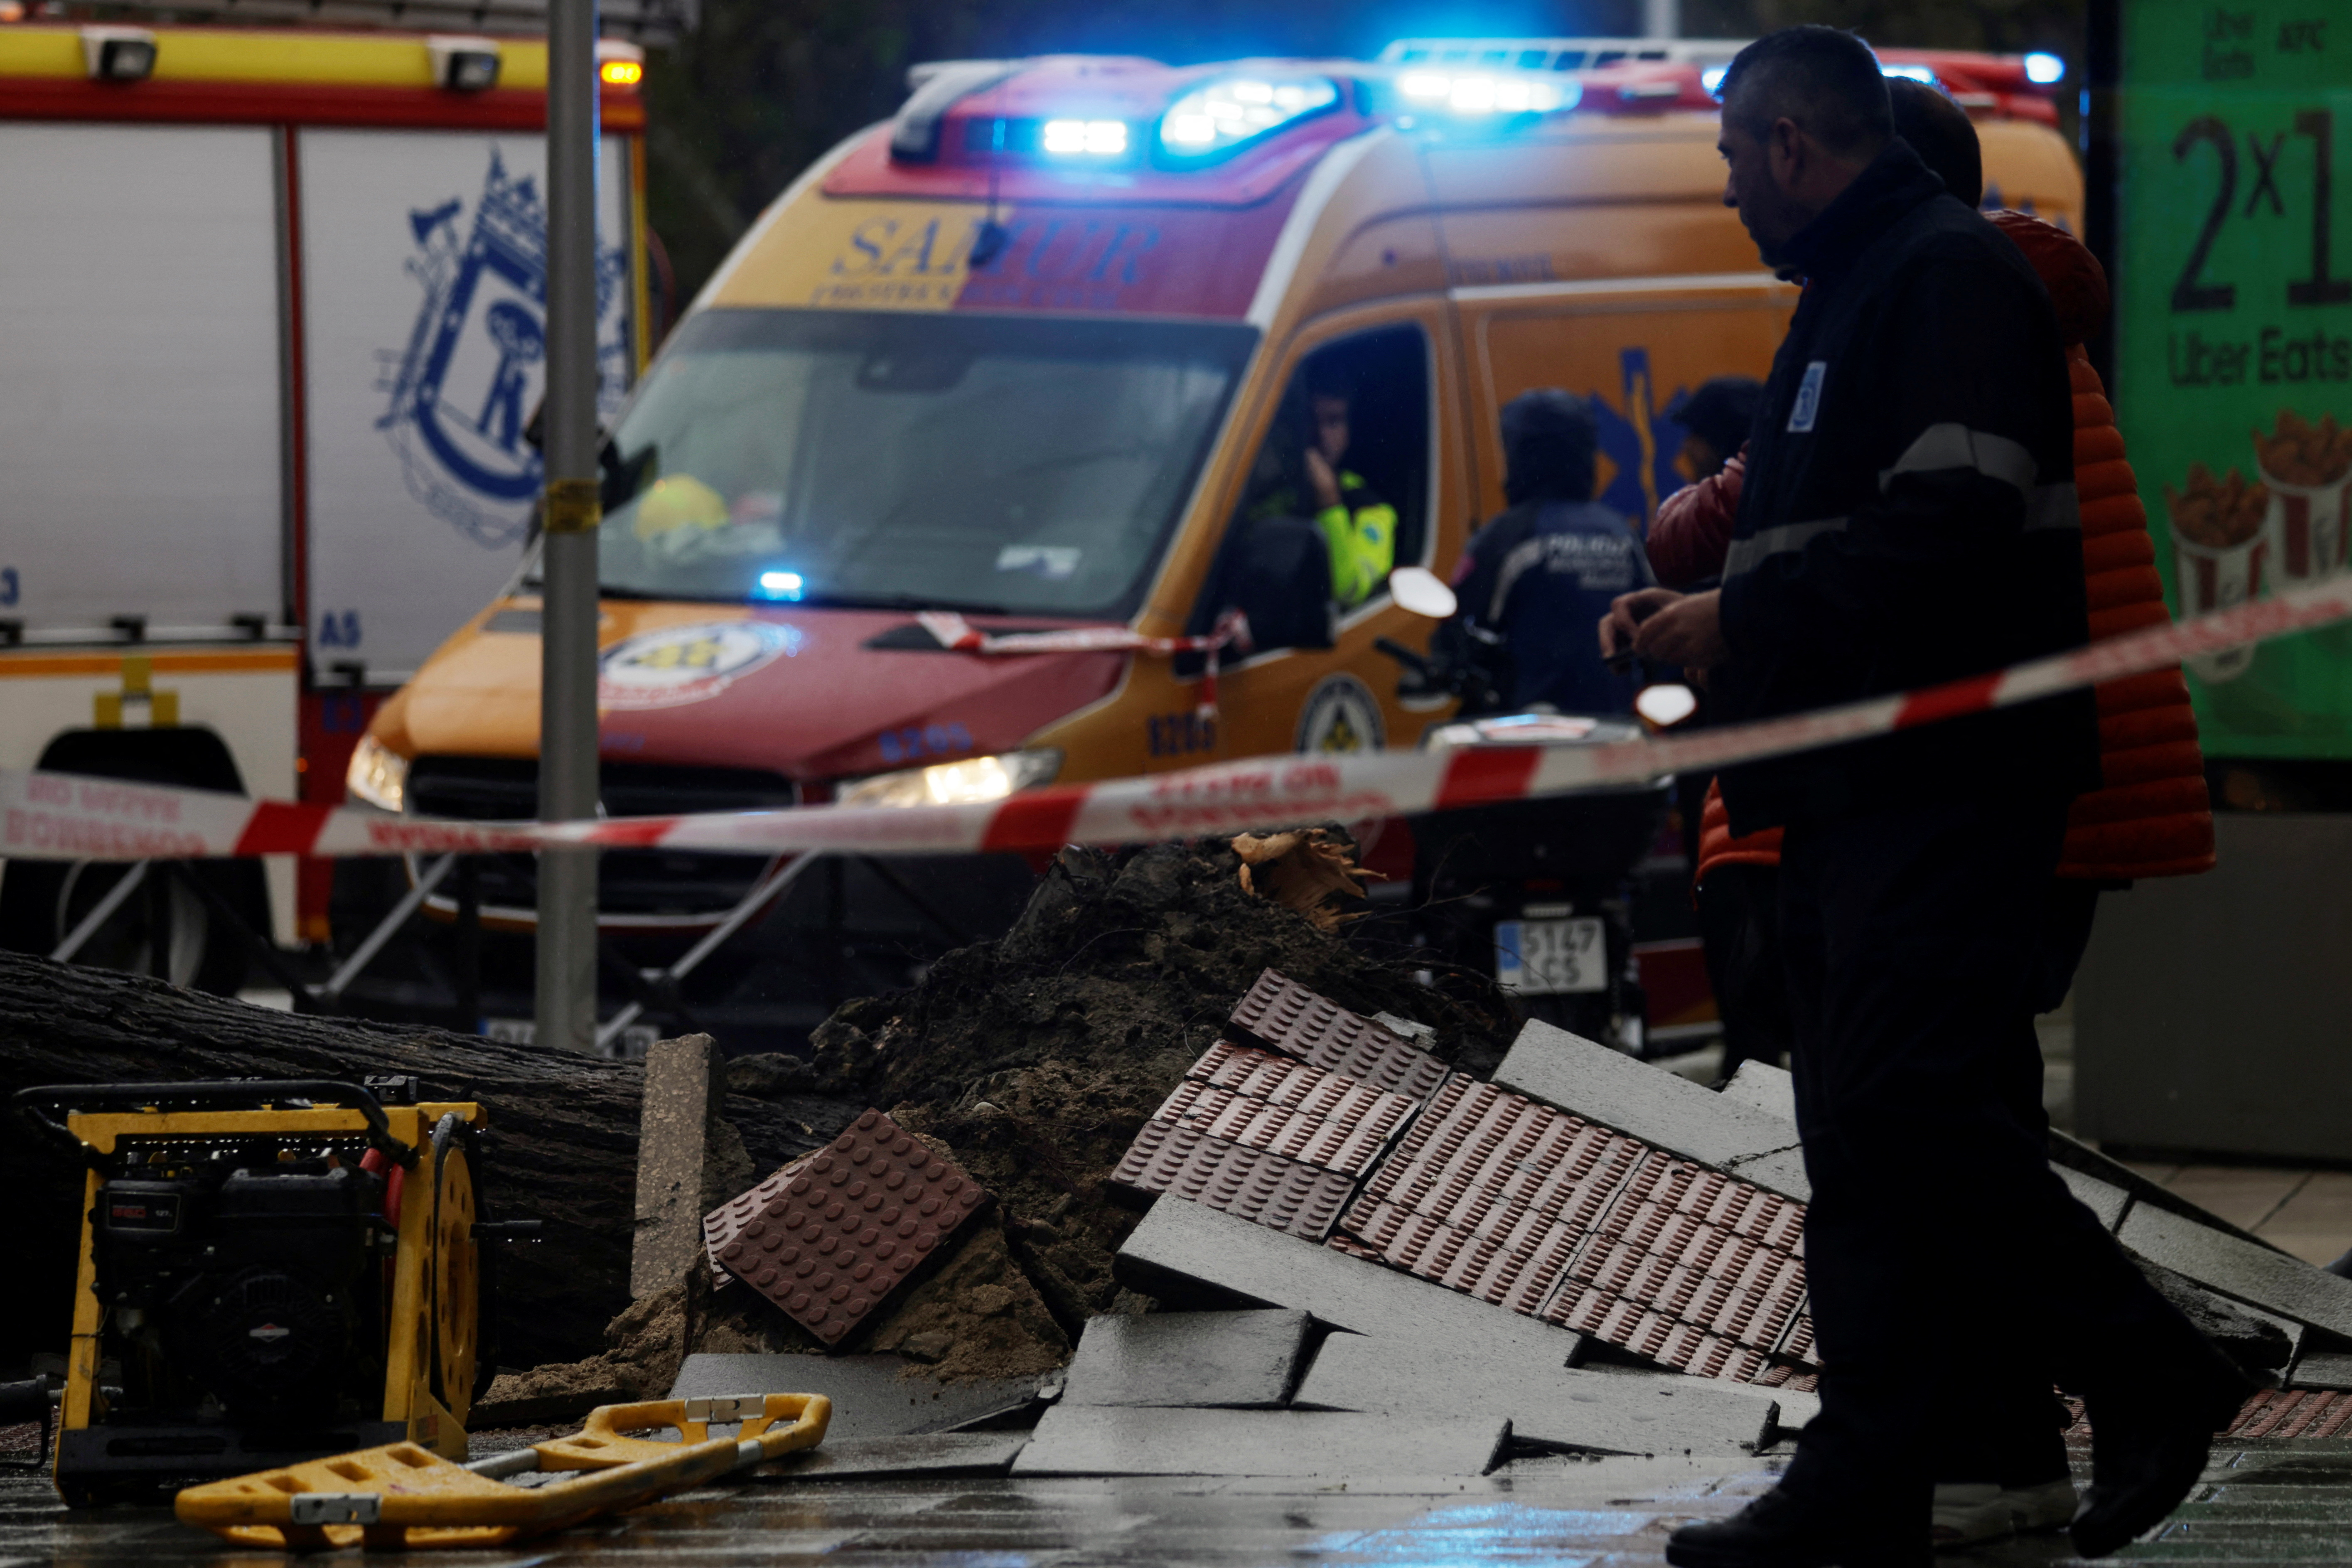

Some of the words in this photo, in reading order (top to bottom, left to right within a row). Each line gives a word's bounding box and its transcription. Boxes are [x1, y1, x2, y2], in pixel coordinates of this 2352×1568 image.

[2168, 330, 2251, 387] Uber
[2256, 326, 2352, 386] Eats
[319, 610, 361, 648] A5
